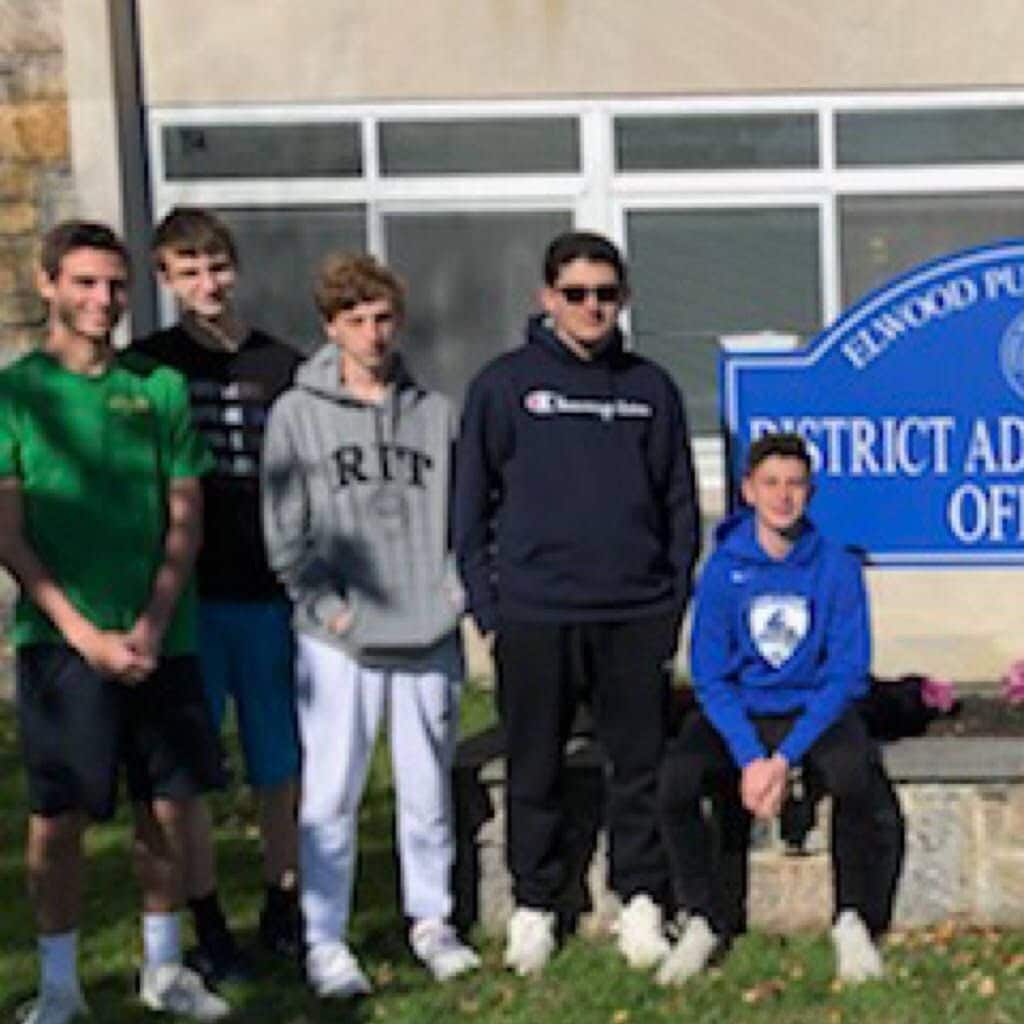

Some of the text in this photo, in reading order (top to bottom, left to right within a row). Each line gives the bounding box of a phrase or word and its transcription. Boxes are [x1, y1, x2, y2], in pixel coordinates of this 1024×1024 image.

[840, 277, 978, 370] ELWOOD
[333, 445, 434, 487] RIT
[750, 416, 956, 475] STRICT
